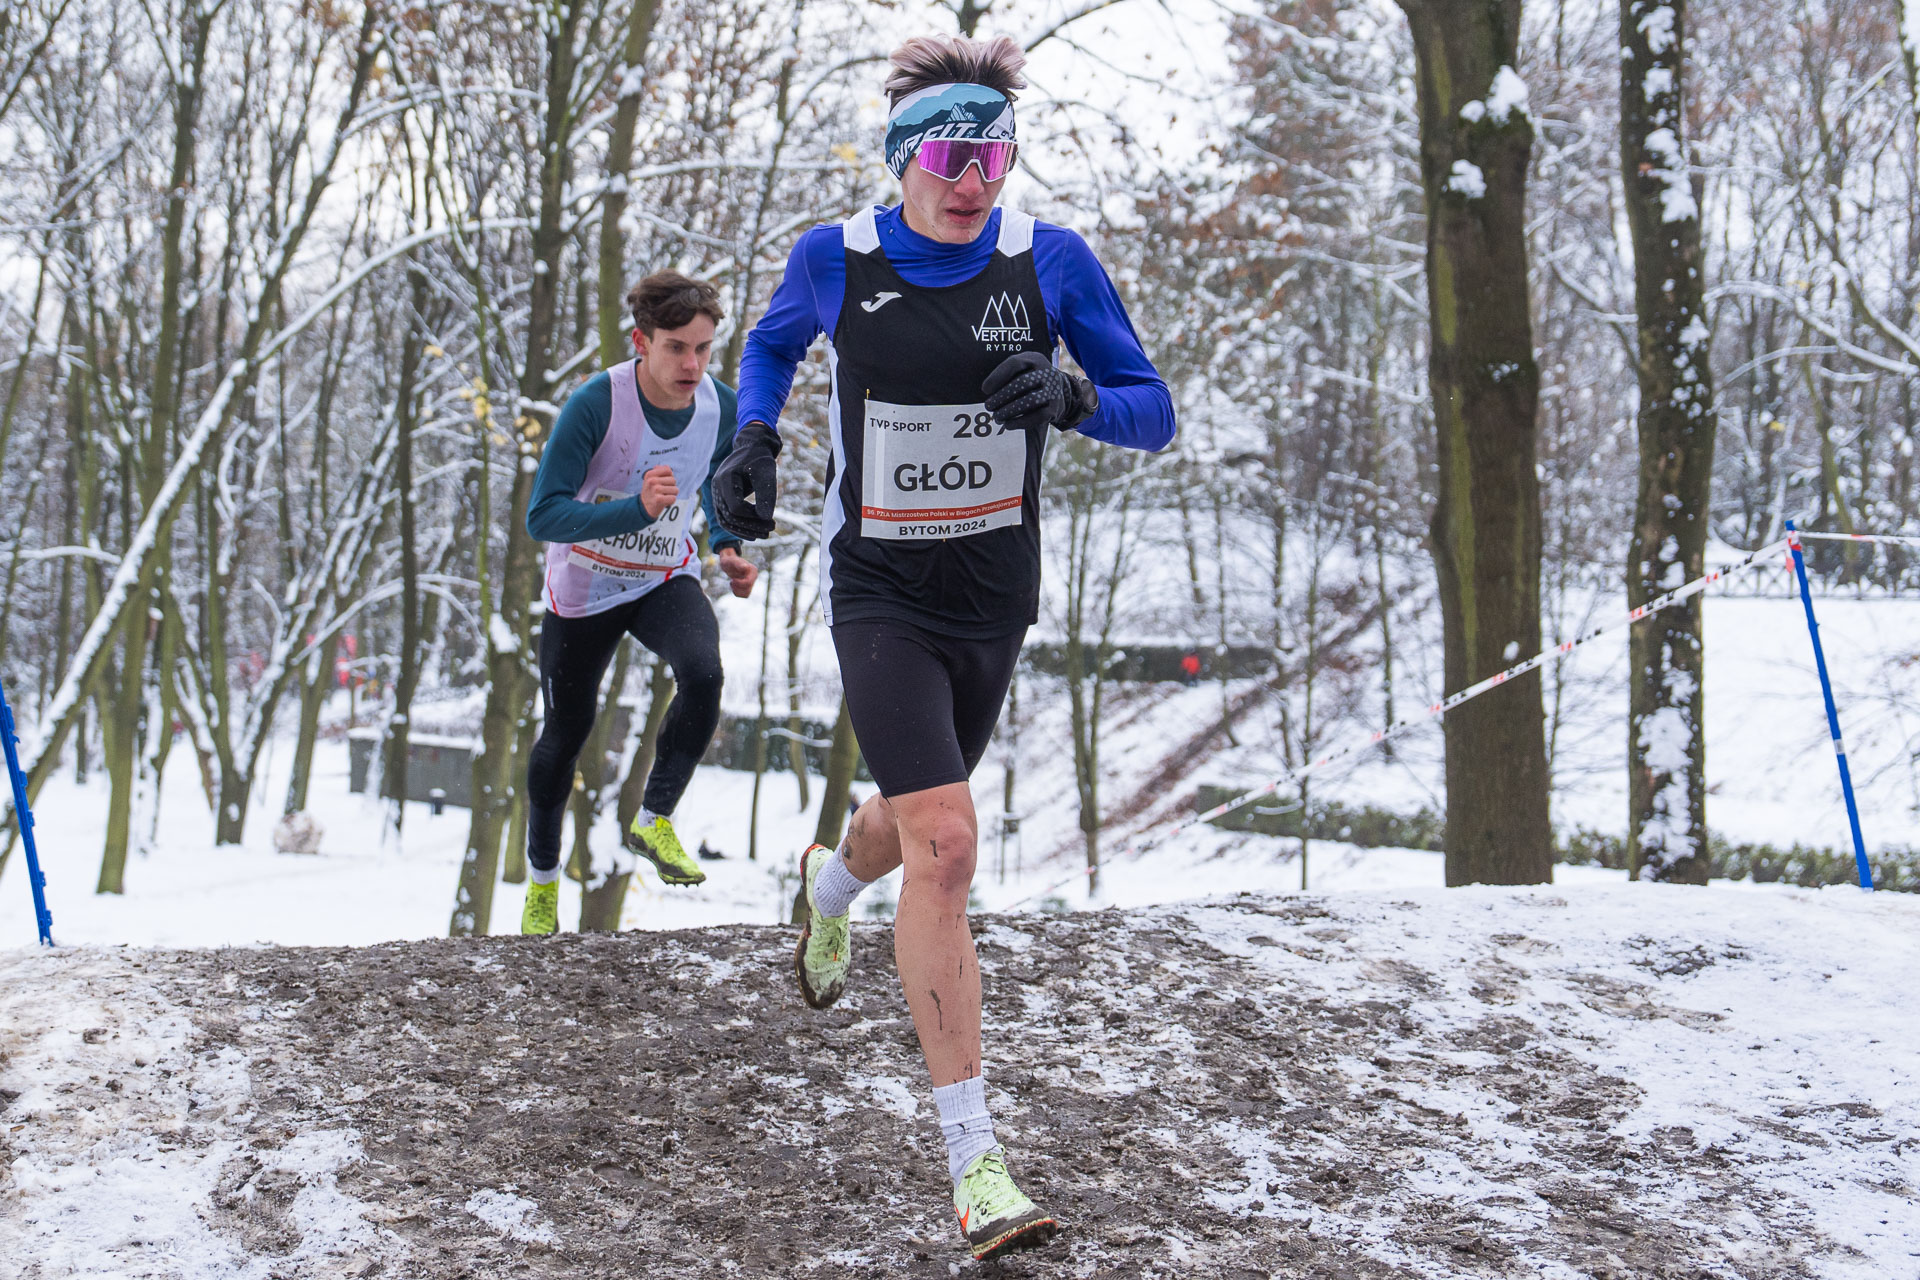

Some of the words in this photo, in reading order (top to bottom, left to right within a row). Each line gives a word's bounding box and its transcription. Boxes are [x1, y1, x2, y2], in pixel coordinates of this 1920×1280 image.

[971, 326, 1034, 342] VERTICAL
[986, 344, 1022, 352] RYTRO
[869, 417, 890, 429] TVP
[892, 421, 932, 432] SPORT
[894, 455, 992, 491] GŁÓD
[956, 508, 981, 517] Biegach
[899, 525, 951, 536] BYTOM
[954, 519, 987, 534] 2024
[597, 533, 677, 557] CHOWSKI
[591, 563, 624, 577] BYTOM
[625, 568, 646, 579] 2024
